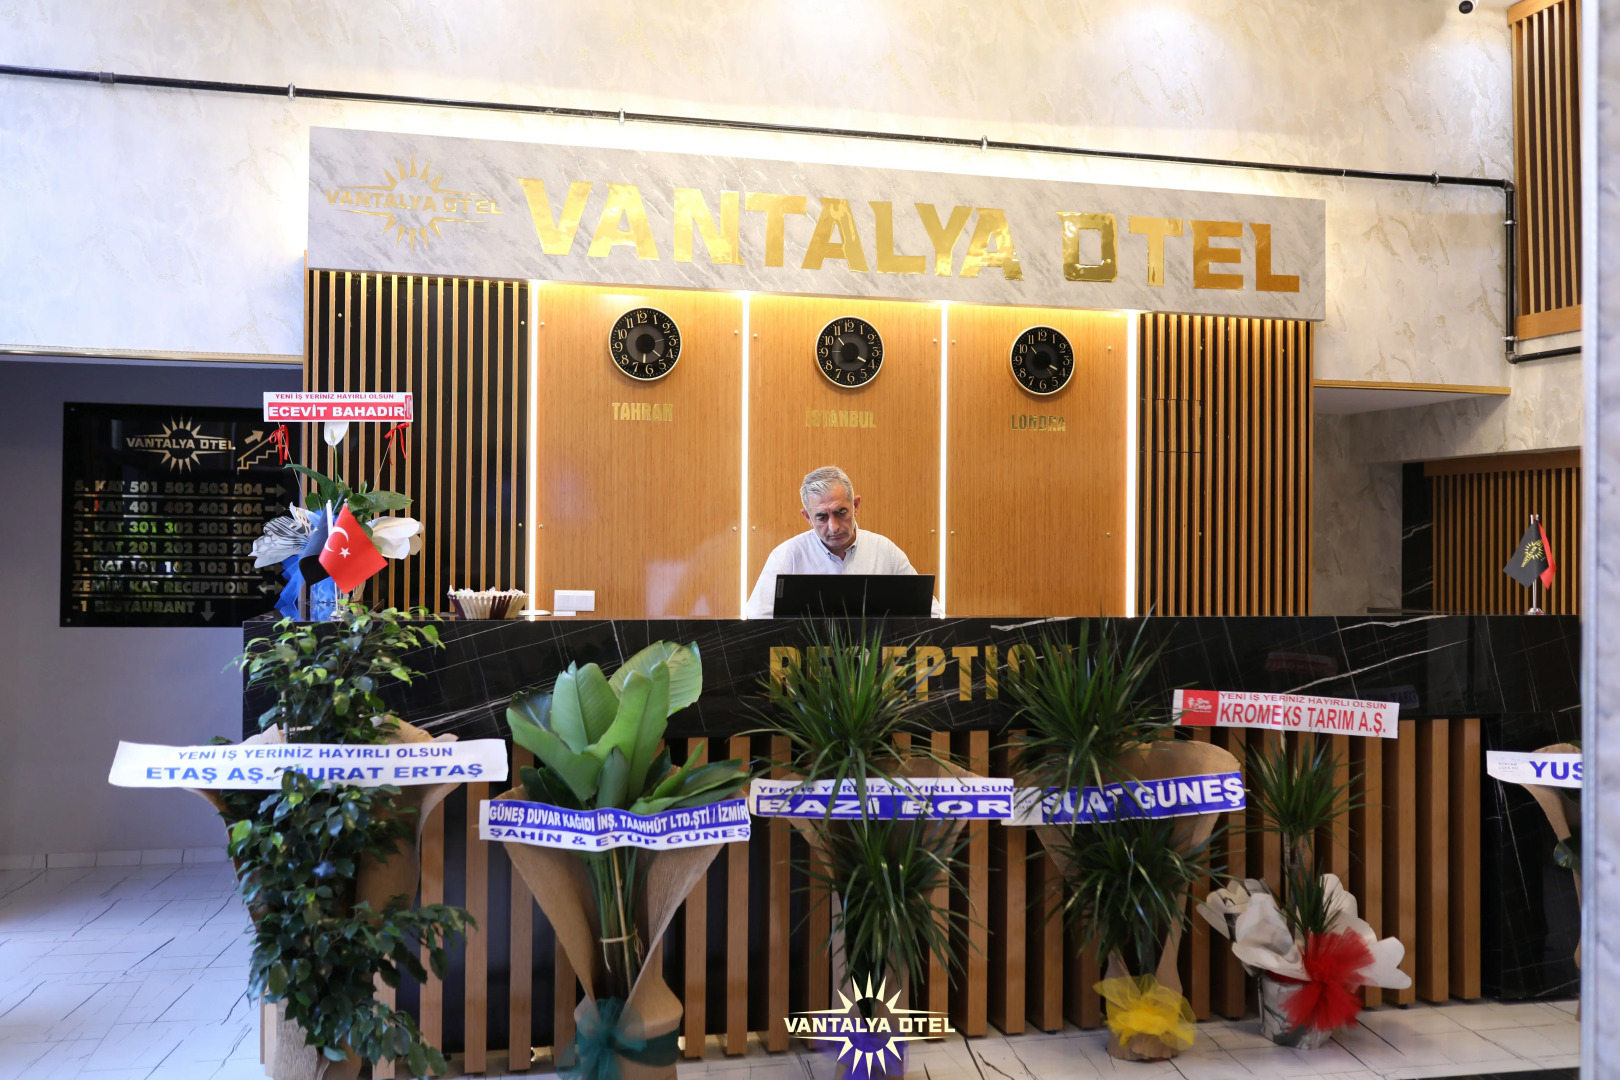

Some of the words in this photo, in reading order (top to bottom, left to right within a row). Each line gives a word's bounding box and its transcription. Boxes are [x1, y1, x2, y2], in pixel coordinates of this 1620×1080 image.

[325, 189, 436, 211] VANTALYA
[444, 197, 503, 215] OTEL
[517, 177, 1024, 282] VANTALYA
[1055, 211, 1300, 293] OTEL
[637, 312, 647, 323] 12
[626, 318, 634, 329] 11
[662, 322, 670, 333] 2
[844, 322, 855, 332] 12
[618, 329, 627, 339] 10
[834, 325, 841, 335] 11
[668, 335, 677, 346] 3
[825, 336, 834, 345] 10
[867, 334, 875, 344] 2
[1028, 334, 1034, 344] 11
[1038, 331, 1047, 341] 12
[614, 342, 623, 352] 9
[820, 347, 829, 358] 9
[872, 346, 879, 357] 3
[1019, 344, 1028, 353] 10
[1059, 343, 1066, 353] 2
[666, 348, 674, 359] 4
[621, 354, 629, 365] 8
[658, 359, 667, 370] 5
[825, 360, 833, 370] 8
[868, 359, 875, 369] 4
[1015, 355, 1023, 365] 9
[1063, 355, 1070, 365] 3
[632, 362, 639, 372] 7
[645, 364, 654, 375] 6
[1019, 368, 1027, 377] 8
[1059, 367, 1066, 377] 4
[835, 368, 842, 379] 7
[847, 372, 855, 383] 6
[860, 369, 868, 379] 5
[1028, 376, 1035, 386] 7
[1039, 379, 1047, 390] 6
[1052, 376, 1059, 386] 5
[268, 405, 327, 417] ECEVİT
[332, 406, 405, 417] BAHADIR
[612, 403, 673, 421] TAHRAN
[1011, 414, 1066, 431] LONDRA
[127, 438, 196, 449] VANTALYA
[200, 439, 236, 451] OTEL
[74, 480, 90, 493] 5.
[95, 480, 125, 493] KAT
[129, 481, 158, 494] 501
[165, 481, 194, 494] 502
[199, 482, 229, 495] 503
[234, 483, 263, 496] 504
[73, 500, 90, 512] 4.
[94, 500, 125, 512] KAT
[129, 501, 158, 513] 401
[164, 501, 194, 514] 402
[199, 502, 228, 514] 403
[233, 502, 263, 515] 404
[73, 520, 89, 532] 3.
[94, 520, 124, 533] KAT
[129, 521, 157, 534] 301
[164, 521, 194, 534] 302
[199, 522, 228, 535] 303
[233, 522, 262, 535] 304
[73, 541, 89, 553] 2.
[93, 541, 124, 553] KAT
[129, 541, 157, 554] 201
[164, 542, 193, 554] 202
[199, 542, 227, 555] 203
[233, 543, 251, 555] 20
[74, 560, 89, 572] 1.
[94, 560, 124, 572] KAT
[130, 561, 157, 573] 101
[164, 561, 193, 573] 102
[199, 562, 227, 574] 103
[129, 581, 159, 593] KAT
[164, 581, 249, 594] RECEPTION
[73, 600, 88, 612] -1
[94, 601, 195, 613] RESTAURANT
[1218, 692, 1245, 701] YENİ
[1249, 692, 1259, 702] İŞ
[1262, 694, 1305, 704] YERİNİZ
[1307, 697, 1349, 707] HAYIRLI
[1352, 700, 1386, 710] OLSUN
[1219, 703, 1301, 727] KROMEKS
[1307, 707, 1355, 731] TARIM
[1357, 711, 1386, 737] A.Ş.
[178, 749, 217, 760] YENİ
[222, 749, 237, 761] İŞ
[244, 747, 313, 759] YERİNİZ
[319, 748, 390, 758] HAYIRLI
[396, 747, 453, 758] OLSUN
[146, 767, 218, 784] ETAŞ
[394, 763, 483, 778] ERTAŞ
[960, 785, 1014, 793] OLSUN
[1042, 787, 1123, 815] SUAT
[1133, 778, 1244, 810] GÜNEŞ
[759, 797, 880, 814] BAZİ
[902, 799, 1011, 815] BOR
[489, 804, 525, 826] GÜNEŞ
[526, 808, 561, 826] DUVAR
[562, 813, 595, 832] KAĞIDI
[619, 813, 668, 833] TAAHHÜT
[718, 802, 749, 823] İZMİR
[489, 828, 562, 843] ŞAHİN
[571, 836, 587, 846] &
[596, 832, 657, 847] EYÜP
[666, 827, 750, 844] GÜNEŞ
